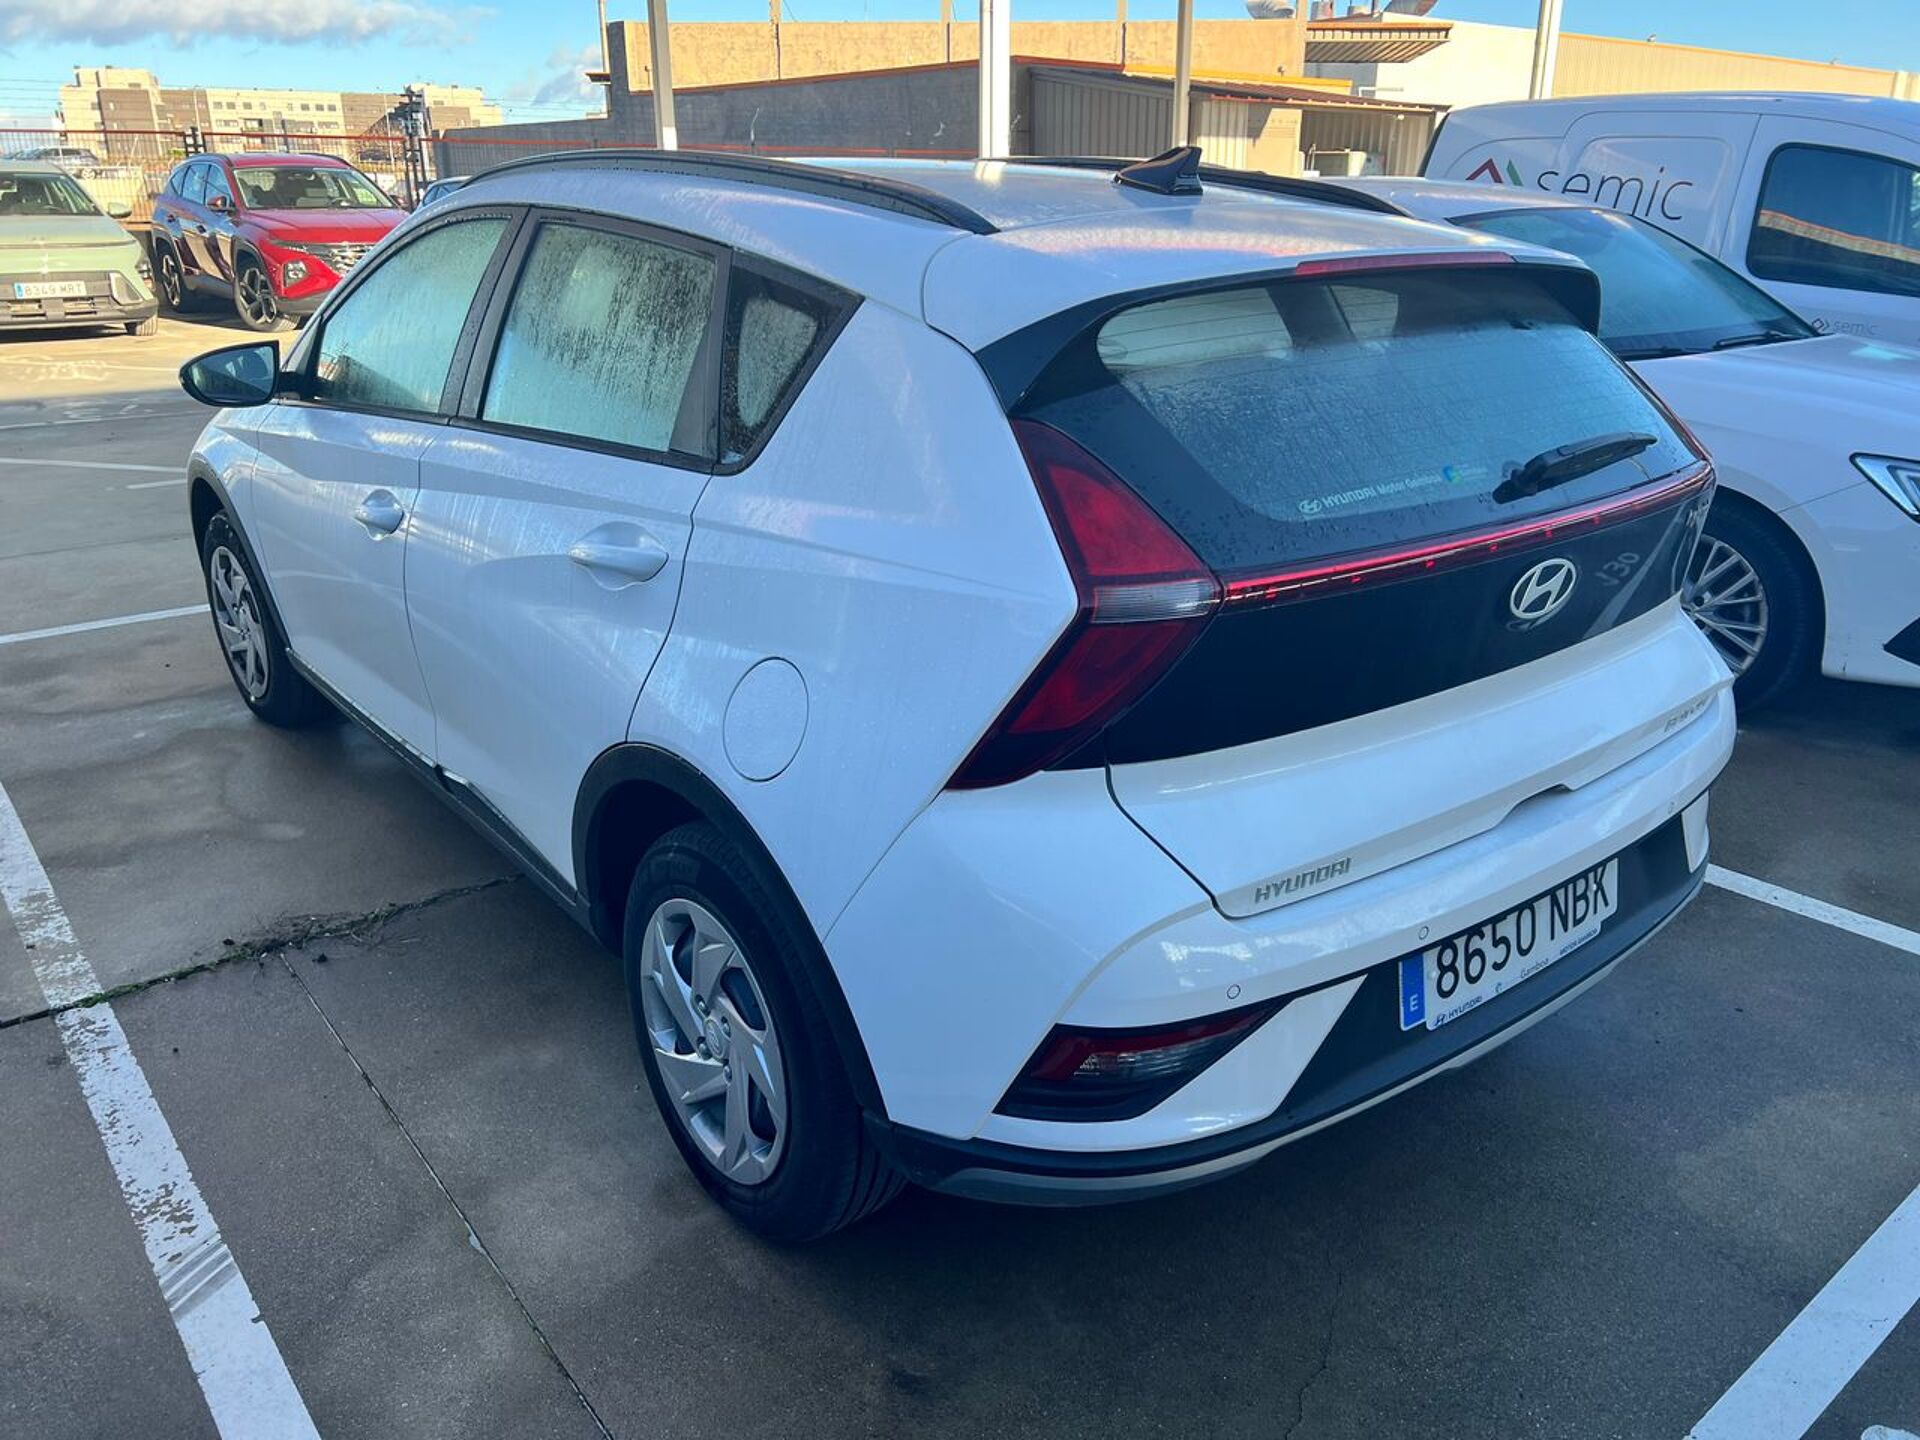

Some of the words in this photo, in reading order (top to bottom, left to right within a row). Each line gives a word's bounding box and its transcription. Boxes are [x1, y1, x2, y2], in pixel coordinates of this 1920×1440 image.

[1537, 165, 1693, 221] semic
[1323, 487, 1377, 508] HYUNDAI
[1254, 857, 1351, 904] HYUNDAI
[1436, 901, 1537, 999] 8650
[1550, 864, 1609, 941] NBK
[1409, 994, 1419, 1012] E
